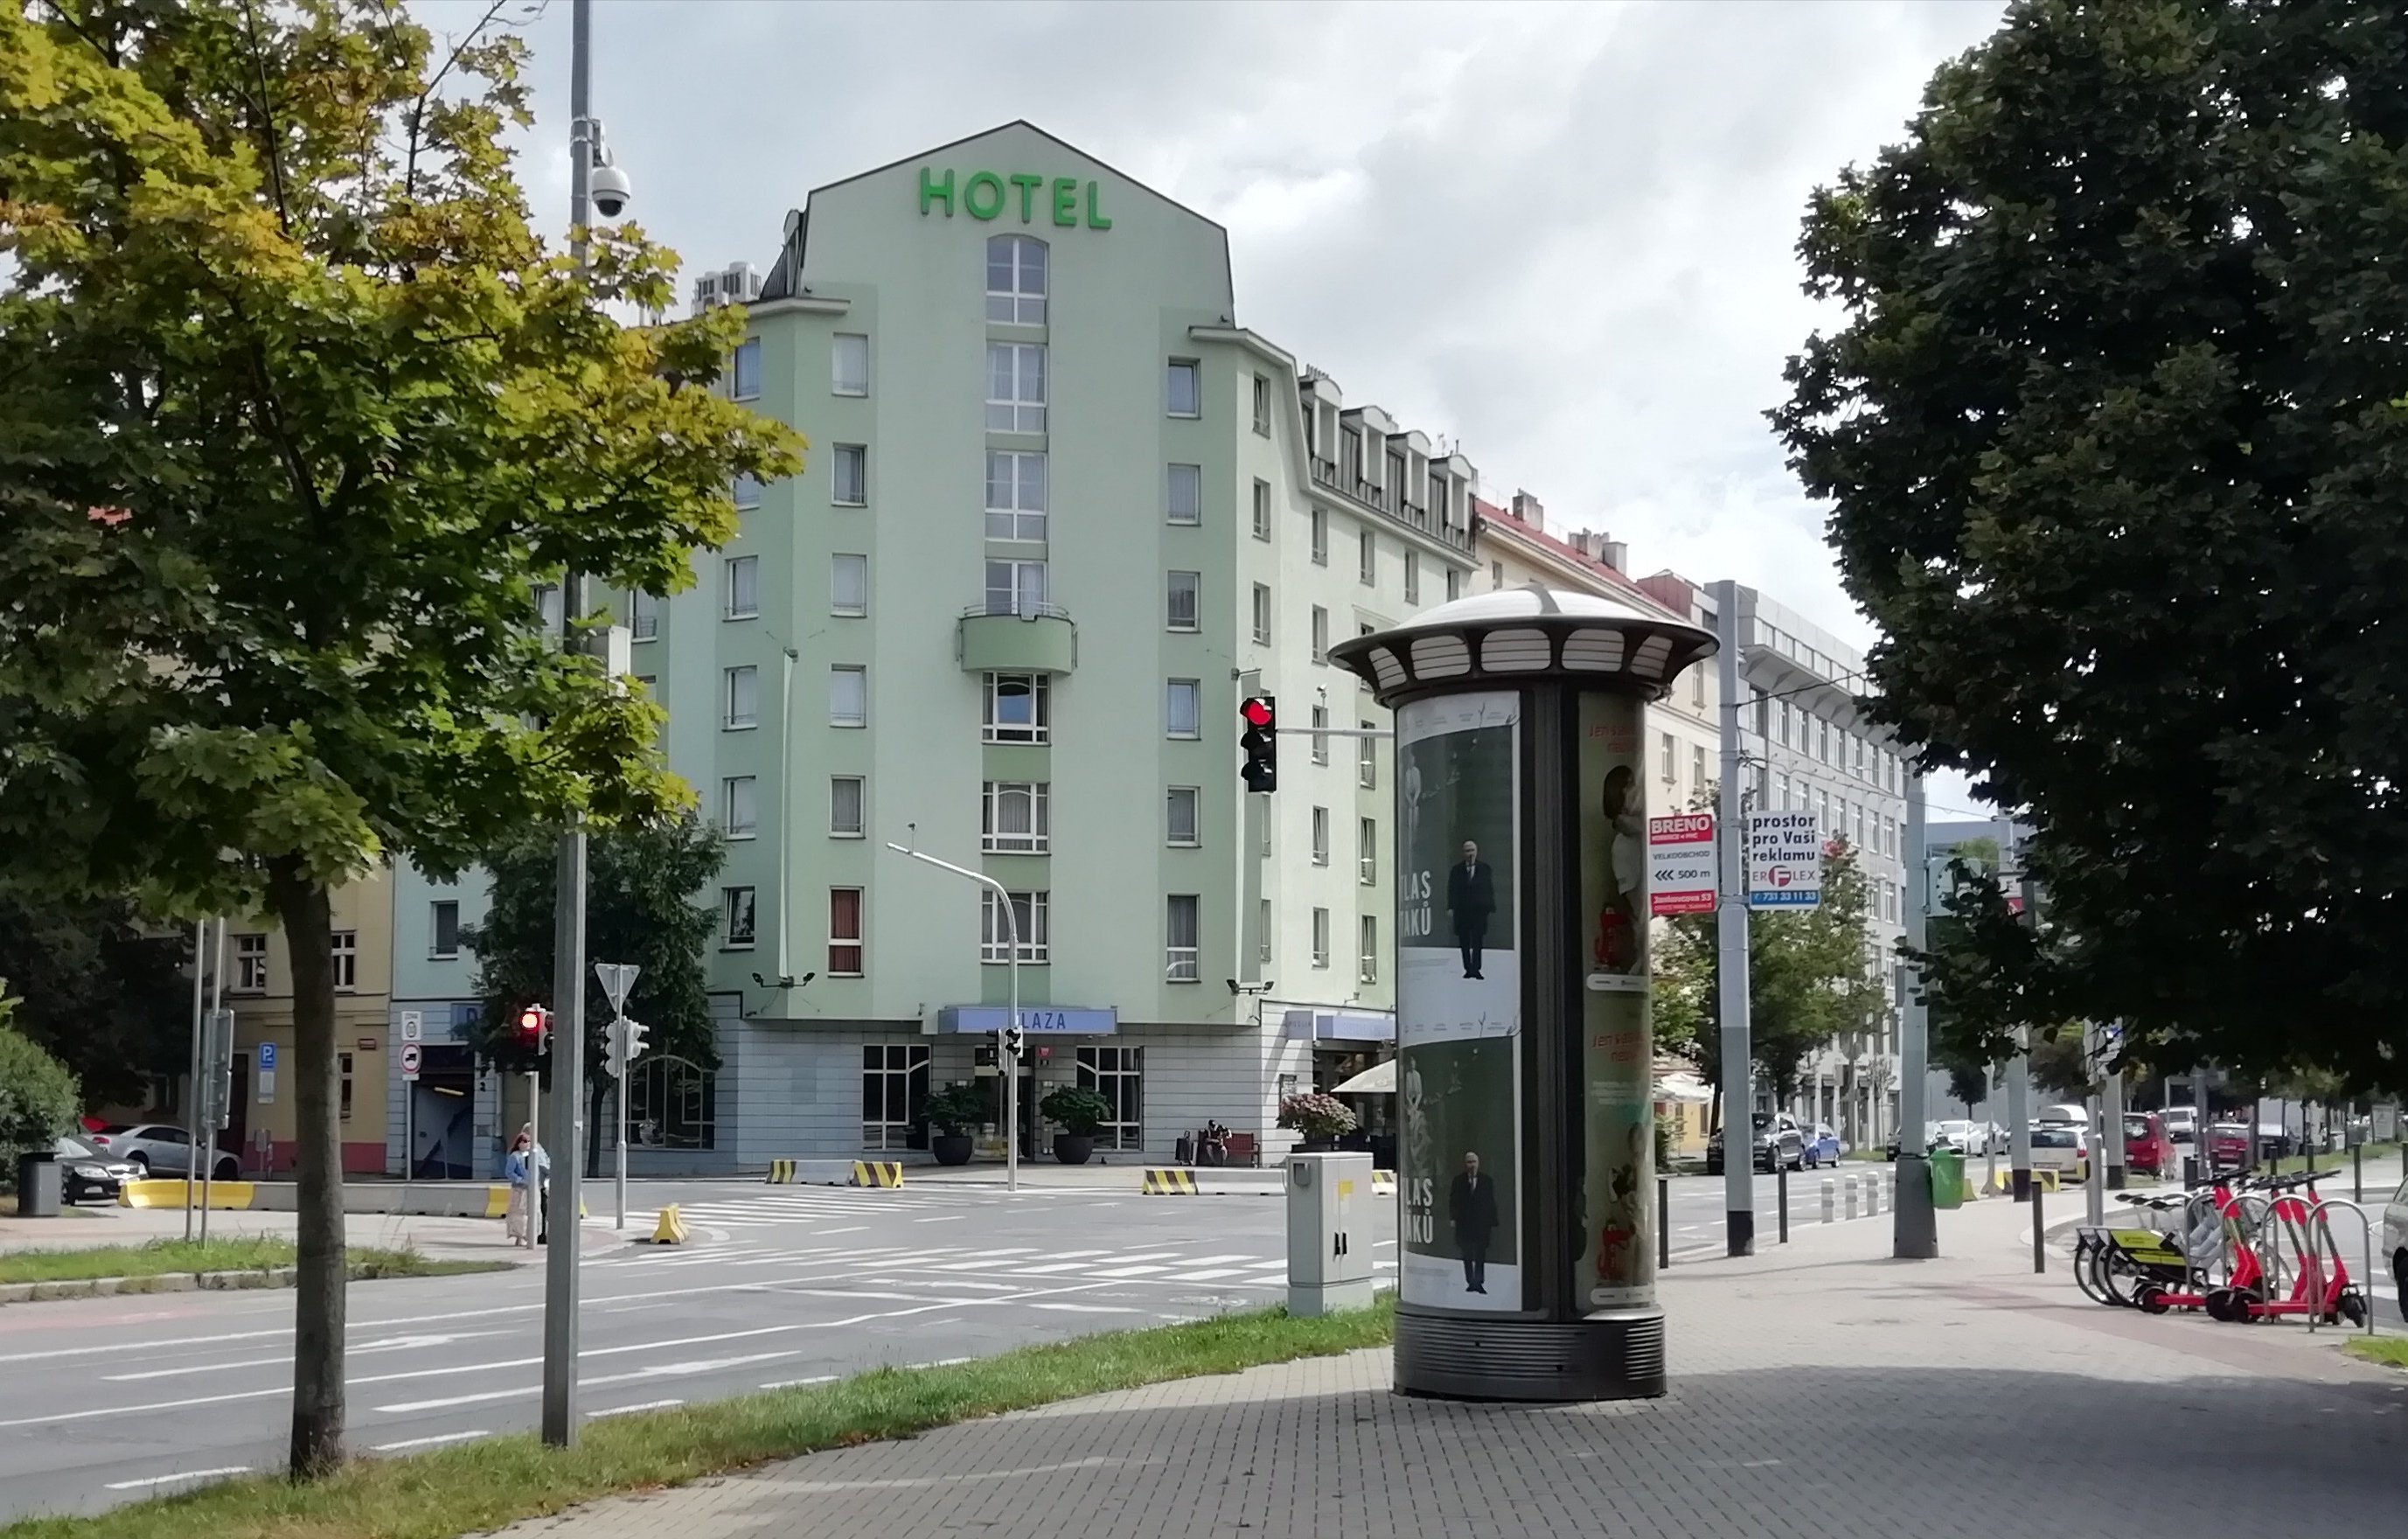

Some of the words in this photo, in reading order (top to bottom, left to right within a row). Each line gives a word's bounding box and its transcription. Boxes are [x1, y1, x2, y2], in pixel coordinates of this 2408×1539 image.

[920, 165, 1112, 229] HOTEL
[1652, 817, 1710, 834] BRENO
[1753, 814, 1815, 832] prostor
[1753, 835, 1778, 848] pro
[1784, 830, 1815, 844] Vaši
[1753, 847, 1815, 861] reklamu
[1678, 870, 1697, 879] 500
[1021, 1013, 1066, 1029] LAZA
